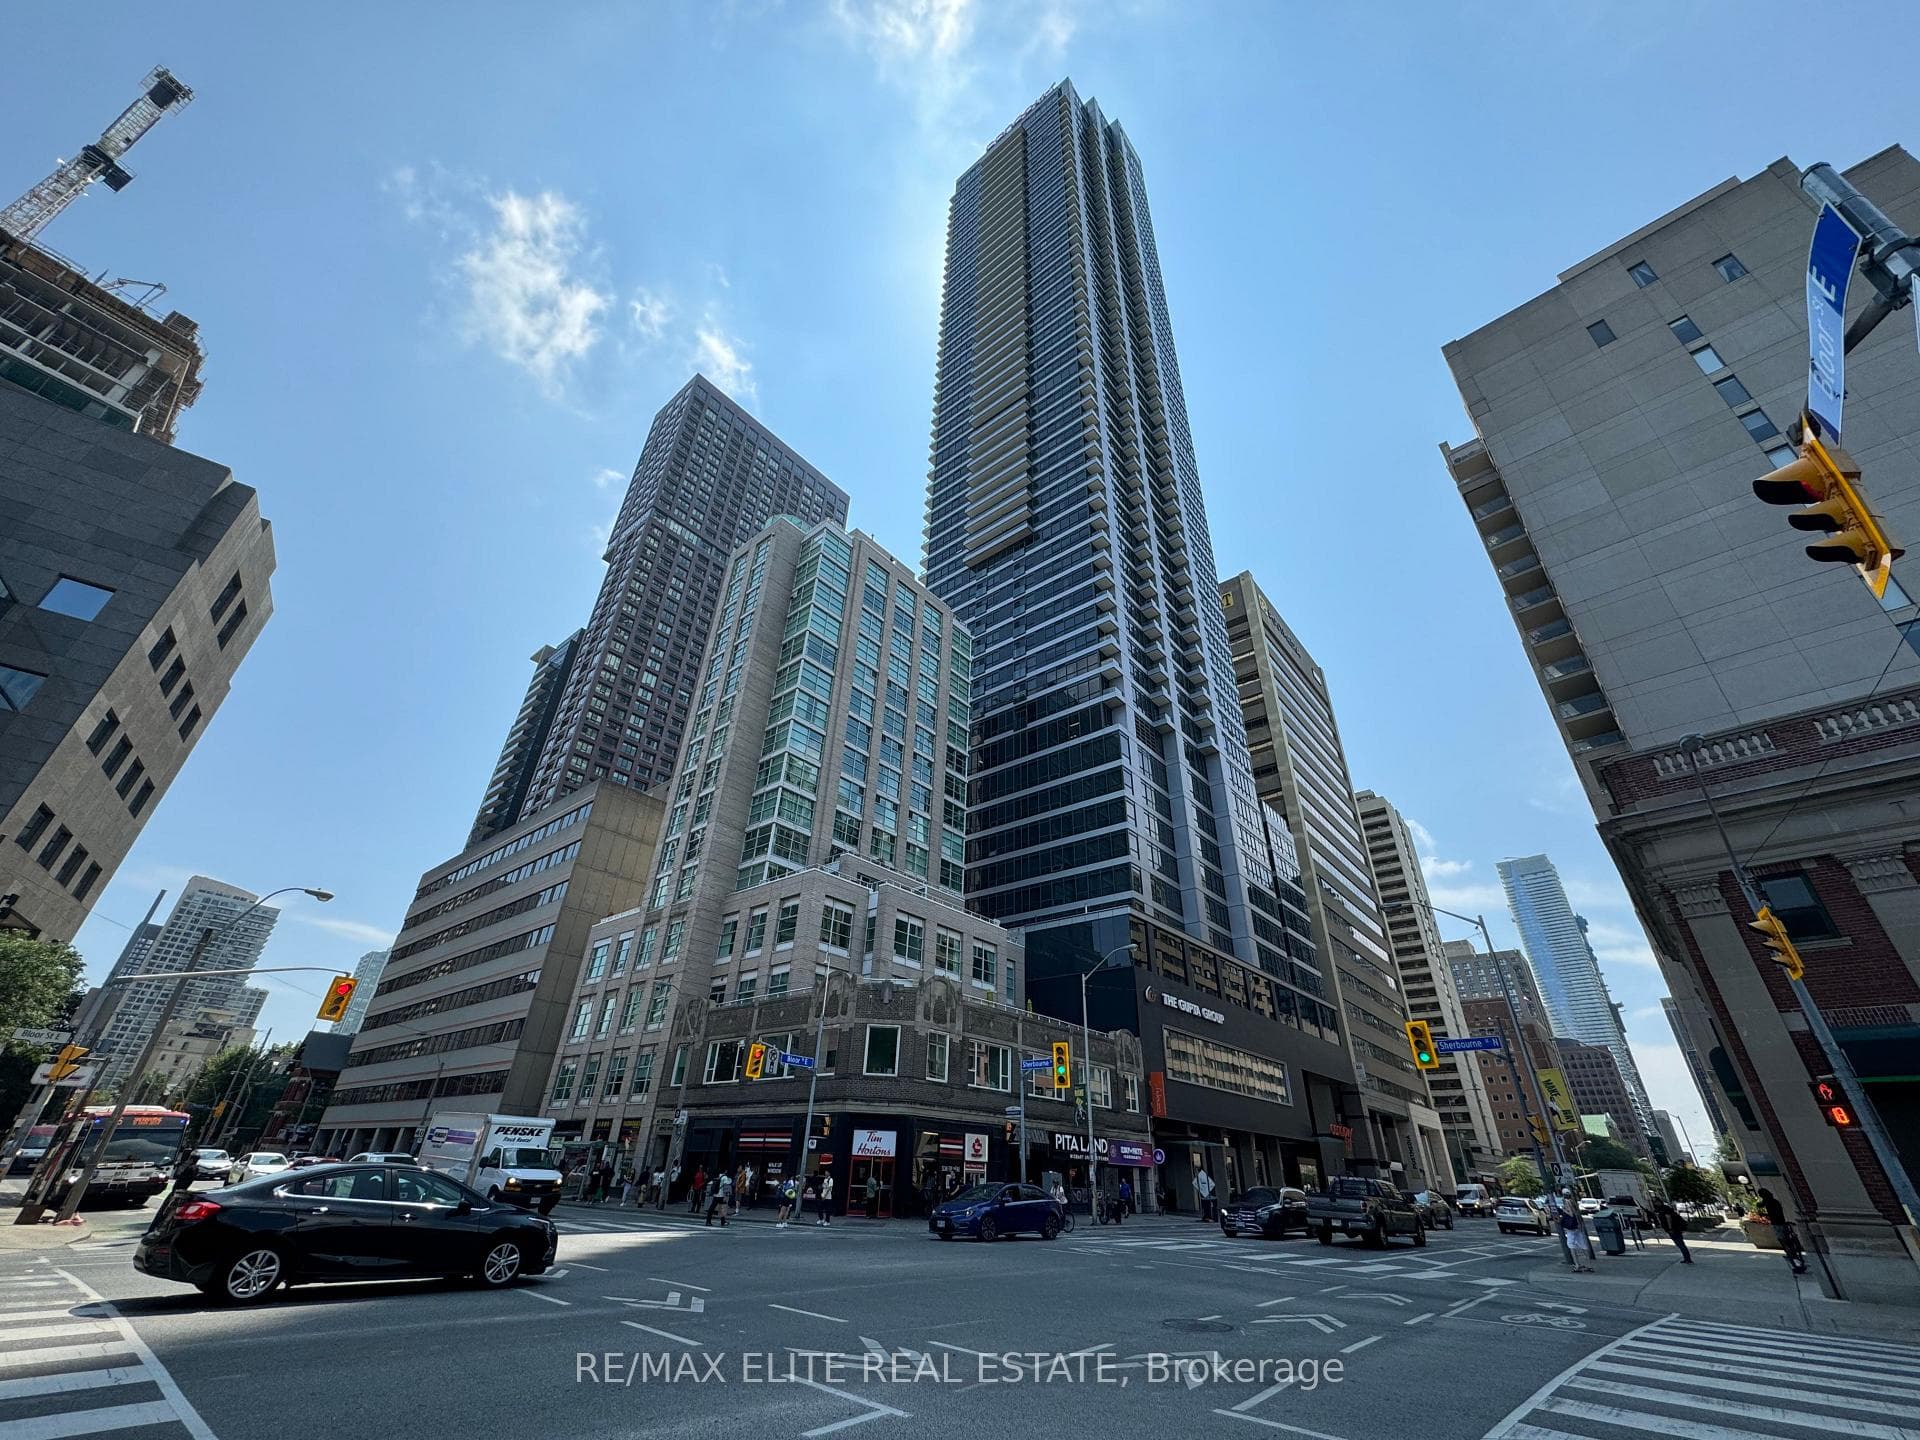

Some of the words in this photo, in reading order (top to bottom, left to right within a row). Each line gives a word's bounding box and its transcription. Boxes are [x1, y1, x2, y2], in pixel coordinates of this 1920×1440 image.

[1811, 265, 1836, 303] E
[1812, 319, 1835, 400] Bloor
[1161, 992, 1178, 1009] THE
[1178, 999, 1202, 1017] GUPTA
[1201, 1007, 1225, 1025] GROUP
[21, 1029, 44, 1039] Bloor
[1440, 1039, 1483, 1050] Sherbourne
[1492, 1037, 1499, 1047] N
[787, 1055, 801, 1064] Bloor
[1022, 1060, 1050, 1069] Sherbourne
[1542, 1079, 1561, 1097] MAKE
[494, 1126, 546, 1137] PENSKE
[866, 1130, 883, 1143] Tim
[1055, 1133, 1079, 1151] PITA
[856, 1142, 891, 1156] Hortons
